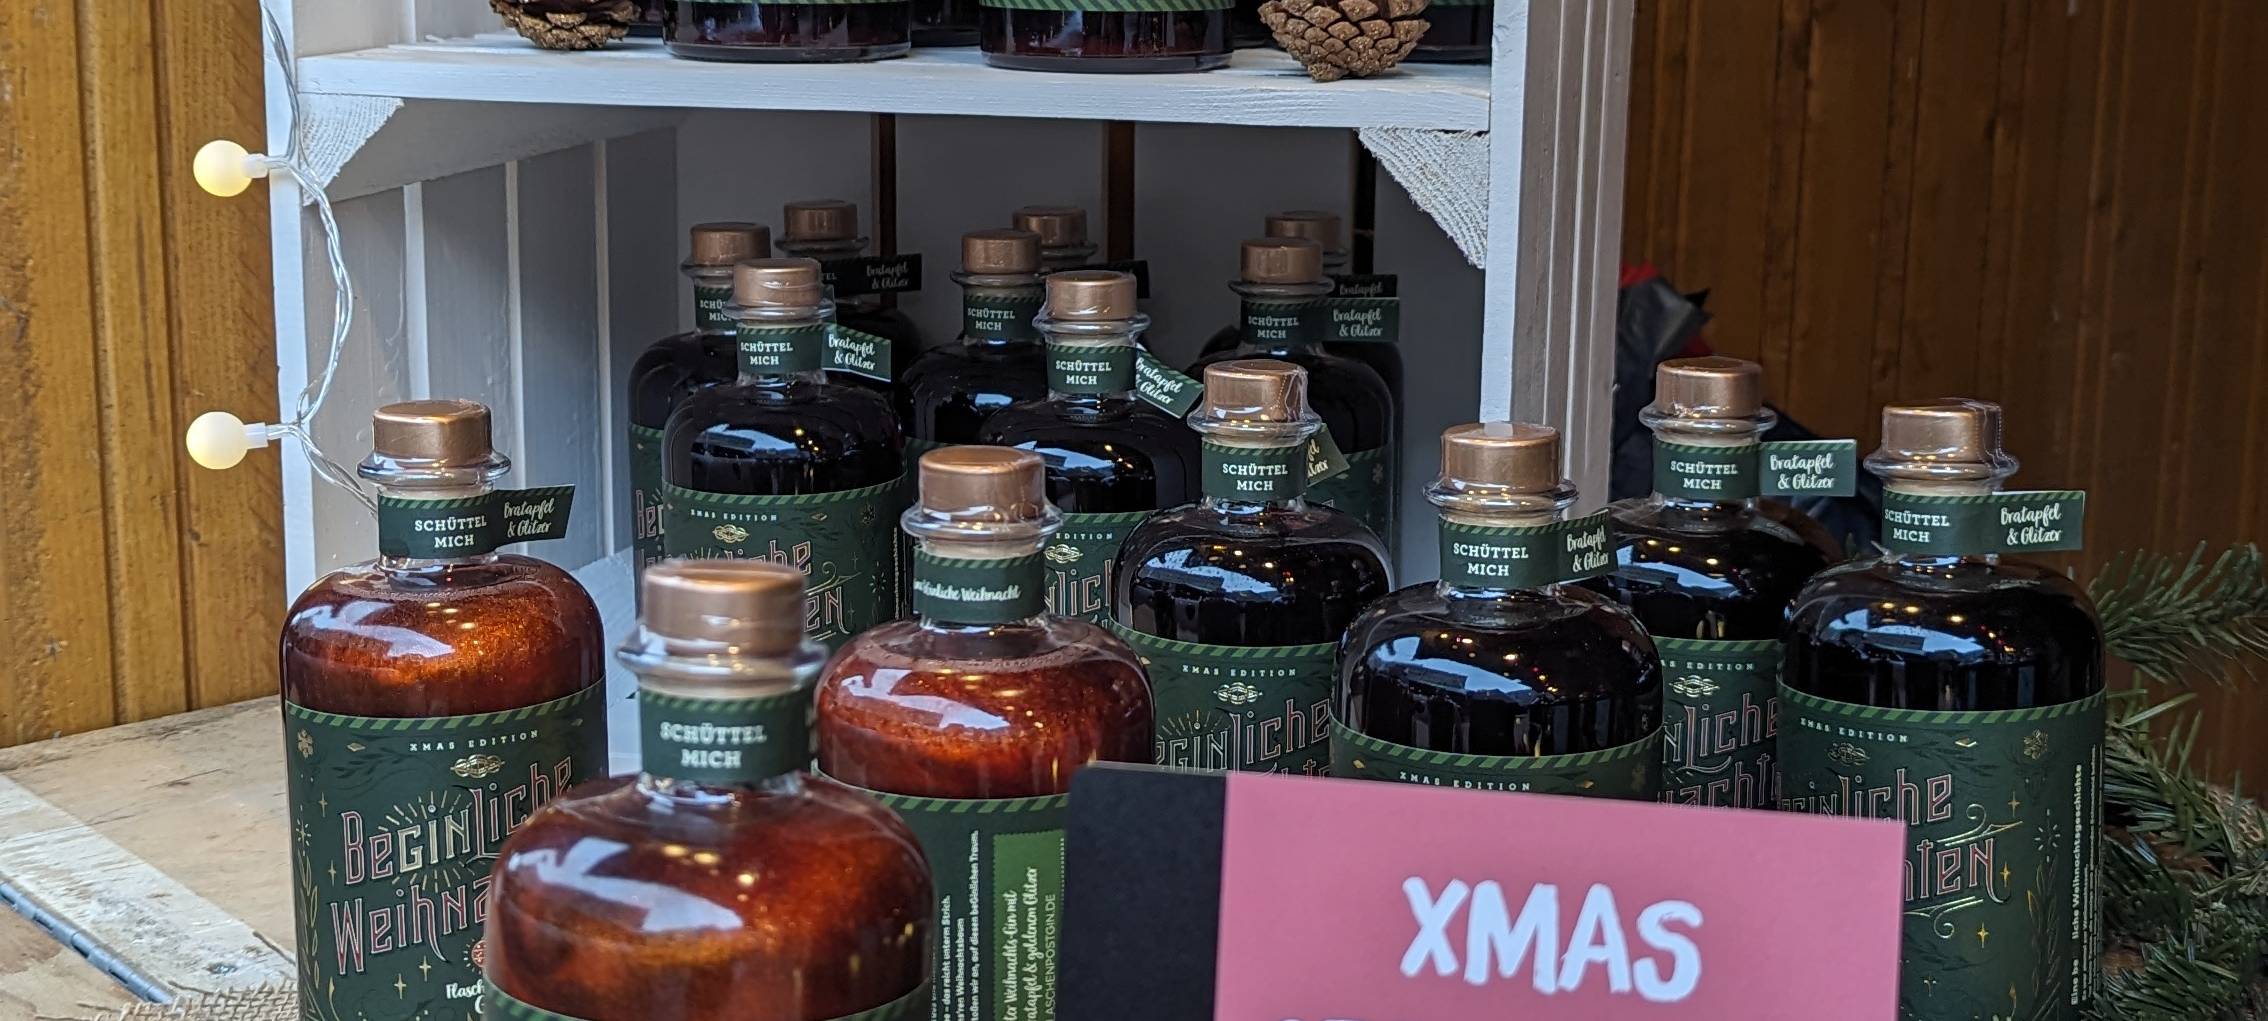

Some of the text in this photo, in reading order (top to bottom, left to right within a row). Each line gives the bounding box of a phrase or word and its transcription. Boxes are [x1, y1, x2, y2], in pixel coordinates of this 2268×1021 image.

[700, 299, 725, 309] SCHÜ
[709, 312, 732, 321] MIC
[968, 307, 1015, 319] SCHÜTTEL
[1248, 316, 1299, 327] SCHÜTTEL
[1333, 308, 1381, 326] Bratapfel
[975, 321, 1001, 331] MICH
[1257, 330, 1286, 339] MICH
[1339, 325, 1349, 337] &
[741, 341, 793, 352] SCHÜTTEL
[829, 333, 875, 355] Bratapfel
[750, 355, 779, 365] MICH
[834, 352, 876, 371] & Glitzer
[1056, 359, 1112, 372] SCHÜTTEL
[1066, 375, 1098, 385] MICH
[1223, 463, 1288, 476] SCHÜTTEL
[1671, 460, 1738, 475] SCHÜTTEL
[1770, 453, 1834, 475] Bratapfel
[1236, 480, 1274, 491] MICH
[1683, 478, 1722, 490] MICH
[1777, 474, 1835, 489] & Glitzer
[504, 498, 555, 520] Bratapfel
[724, 513, 777, 521] EDITION
[1884, 508, 1950, 526] SCHÜTTEL
[2000, 503, 2061, 527] Bratapfel
[415, 515, 488, 532] SCHÜTTEL
[507, 520, 552, 538] & Glitzer
[434, 534, 474, 548] MICH
[1056, 532, 1113, 540] EDITION
[1566, 525, 1607, 552] Bratapfel
[1893, 528, 1930, 543] MICH
[2006, 527, 2062, 546] & Glitzer
[1453, 542, 1529, 559] SCHÜTTEL
[1467, 563, 1509, 577] MICH
[1572, 556, 1582, 573] &
[961, 584, 1021, 602] Weihnacht
[1182, 664, 1296, 677] XMAS EDITION
[1687, 662, 1754, 670] EDITION
[410, 730, 538, 752] XMAS EDITION
[660, 721, 767, 745] SCHÜTTEL
[1839, 727, 1908, 743] EDITION
[681, 749, 742, 769] MICH
[1400, 771, 1530, 791] XMAS EDITION
[2072, 764, 2082, 904] Weihnachtsgeschichte
[1023, 866, 1038, 905] Glitzer
[330, 874, 492, 975] Weihna
[969, 916, 979, 945] diesen
[1021, 906, 1044, 958] goldenem
[941, 926, 951, 958] unterm
[1400, 876, 1703, 1003] XMAS
[955, 917, 965, 995] Weihnachtsbaum
[970, 946, 979, 961] auf
[1002, 889, 1018, 1021] ter Weihnachts-Gin mit
[1045, 893, 1056, 1021] LASCHENPOSTGIN.DE
[941, 960, 951, 987] reicht
[1024, 959, 1038, 972] &
[446, 979, 485, 999] Flasch
[970, 978, 979, 994] wir
[970, 995, 979, 1021] toßen
